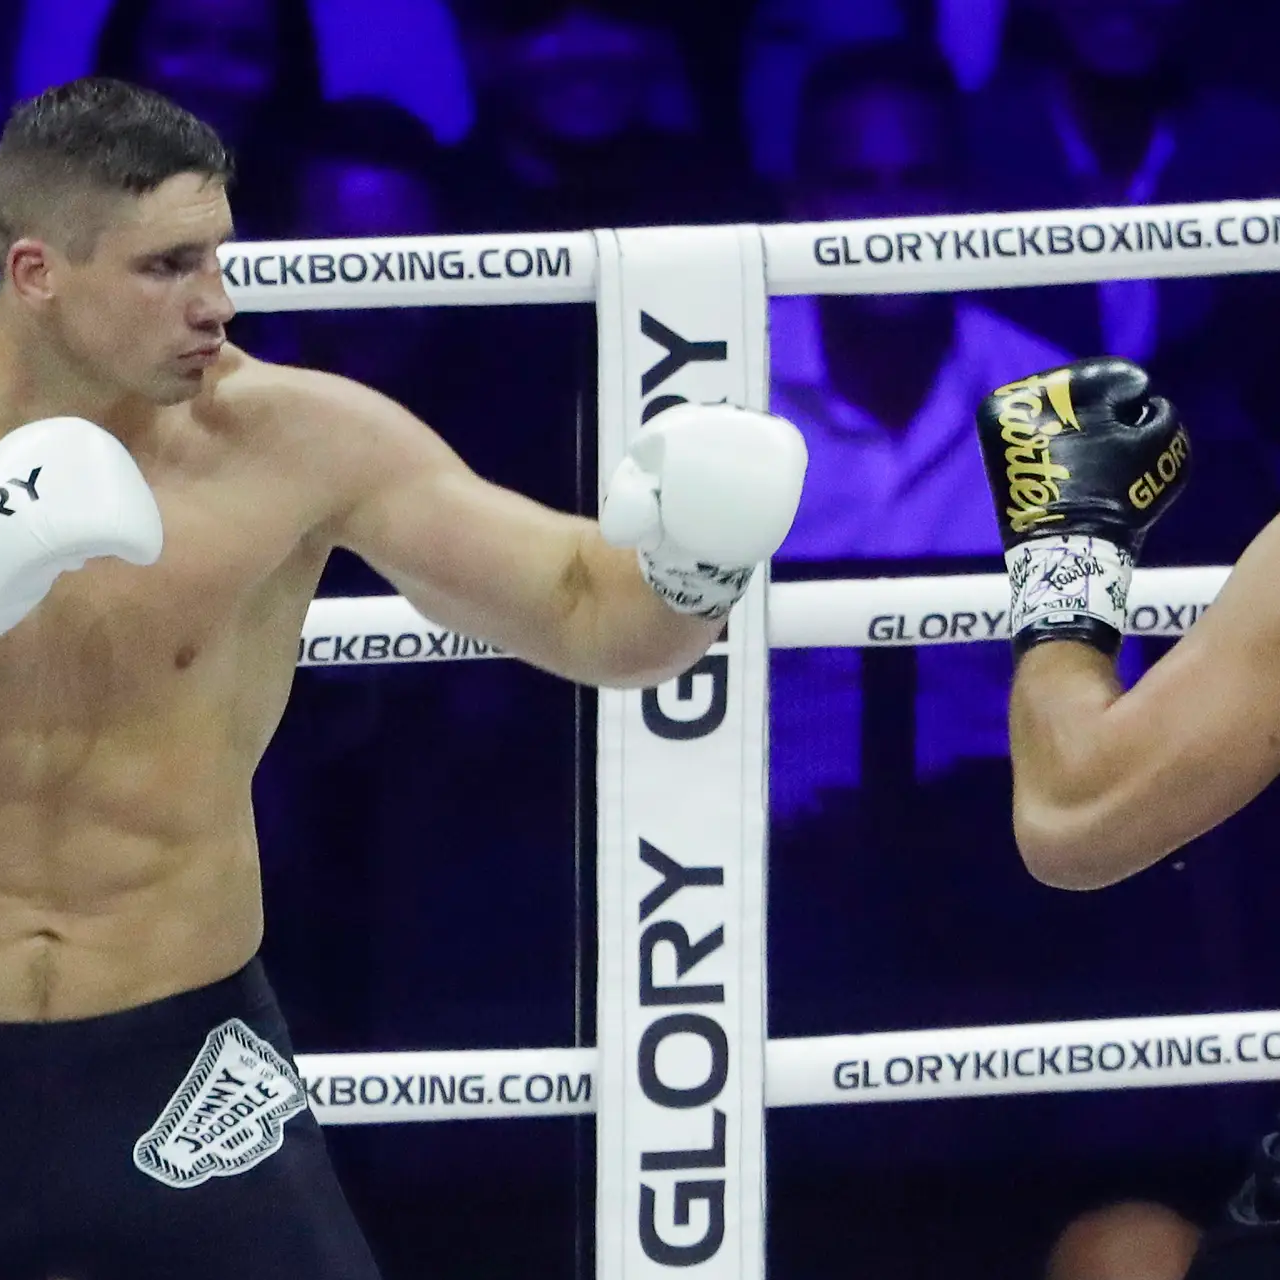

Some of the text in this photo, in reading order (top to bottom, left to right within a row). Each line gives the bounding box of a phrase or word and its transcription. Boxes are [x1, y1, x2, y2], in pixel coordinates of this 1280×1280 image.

[992, 367, 1081, 533] Fairtex
[174, 1067, 246, 1154] JOHNNY
[200, 1080, 279, 1145] DOODLE
[637, 837, 729, 1268] GLORY
